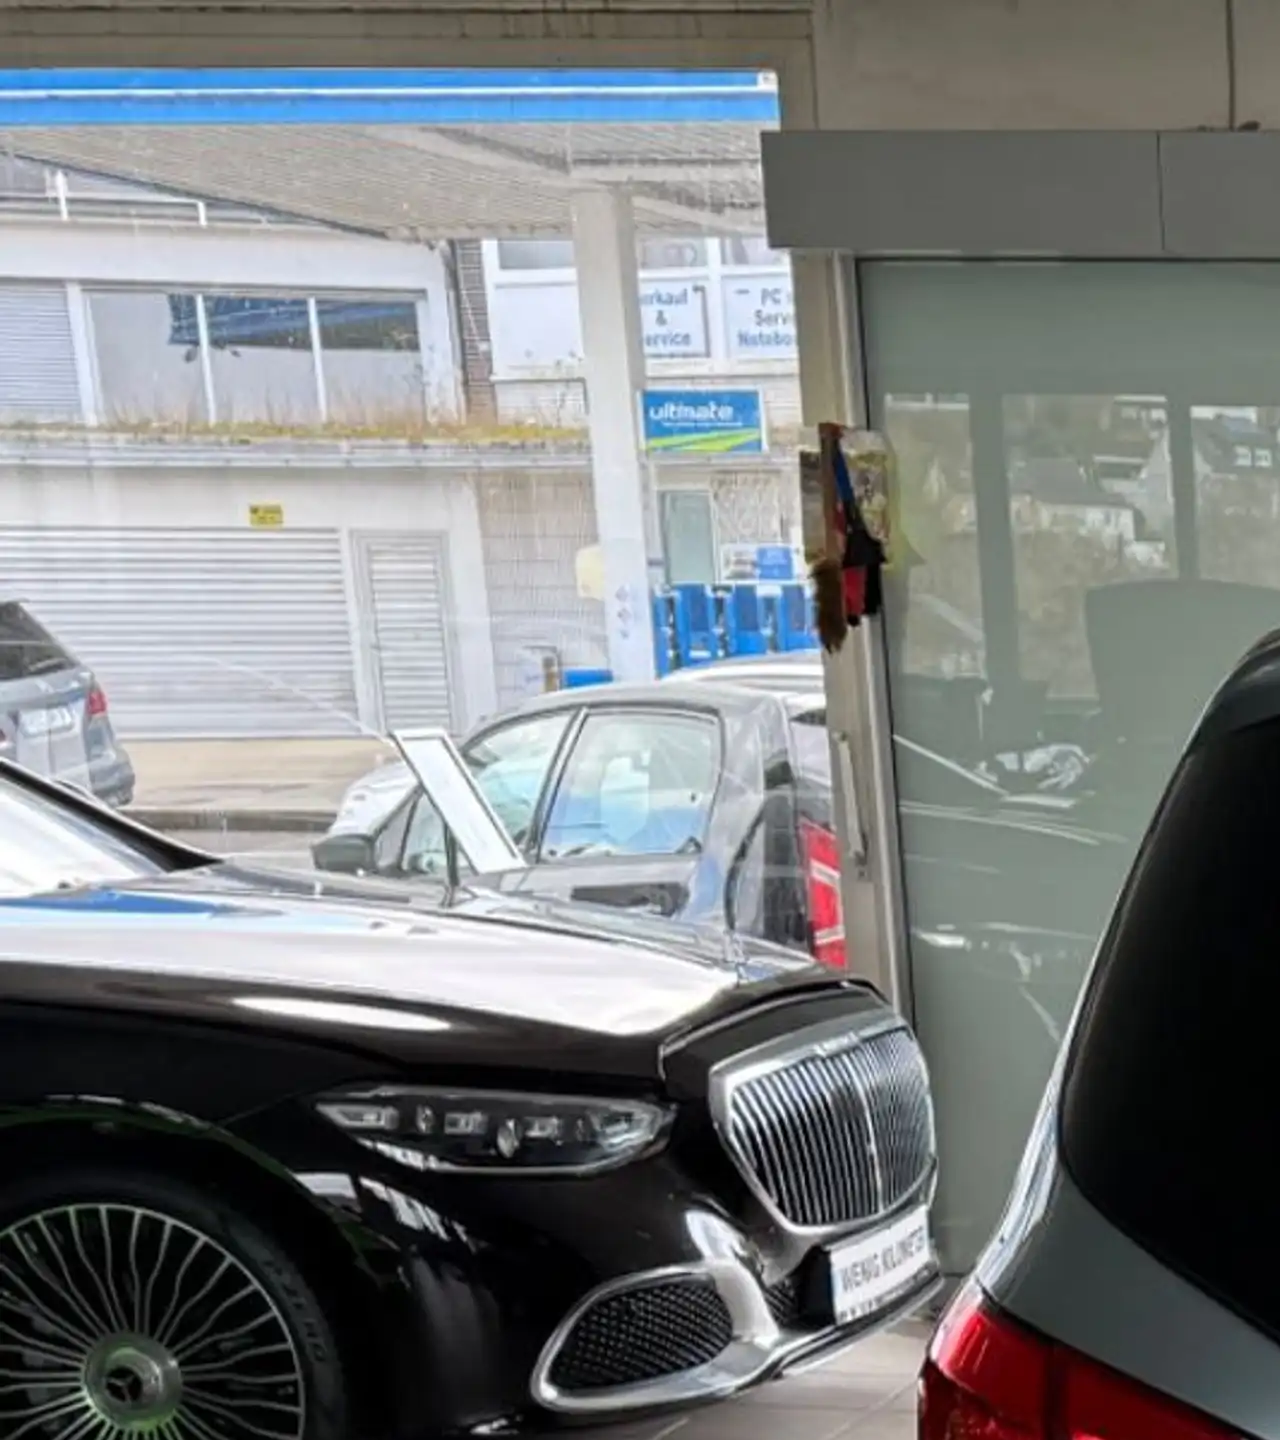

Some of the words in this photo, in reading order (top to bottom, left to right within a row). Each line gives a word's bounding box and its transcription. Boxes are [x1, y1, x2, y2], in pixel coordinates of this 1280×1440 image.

[641, 288, 688, 305] erkauf
[643, 333, 692, 348] ervice
[650, 400, 735, 422] ultimate
